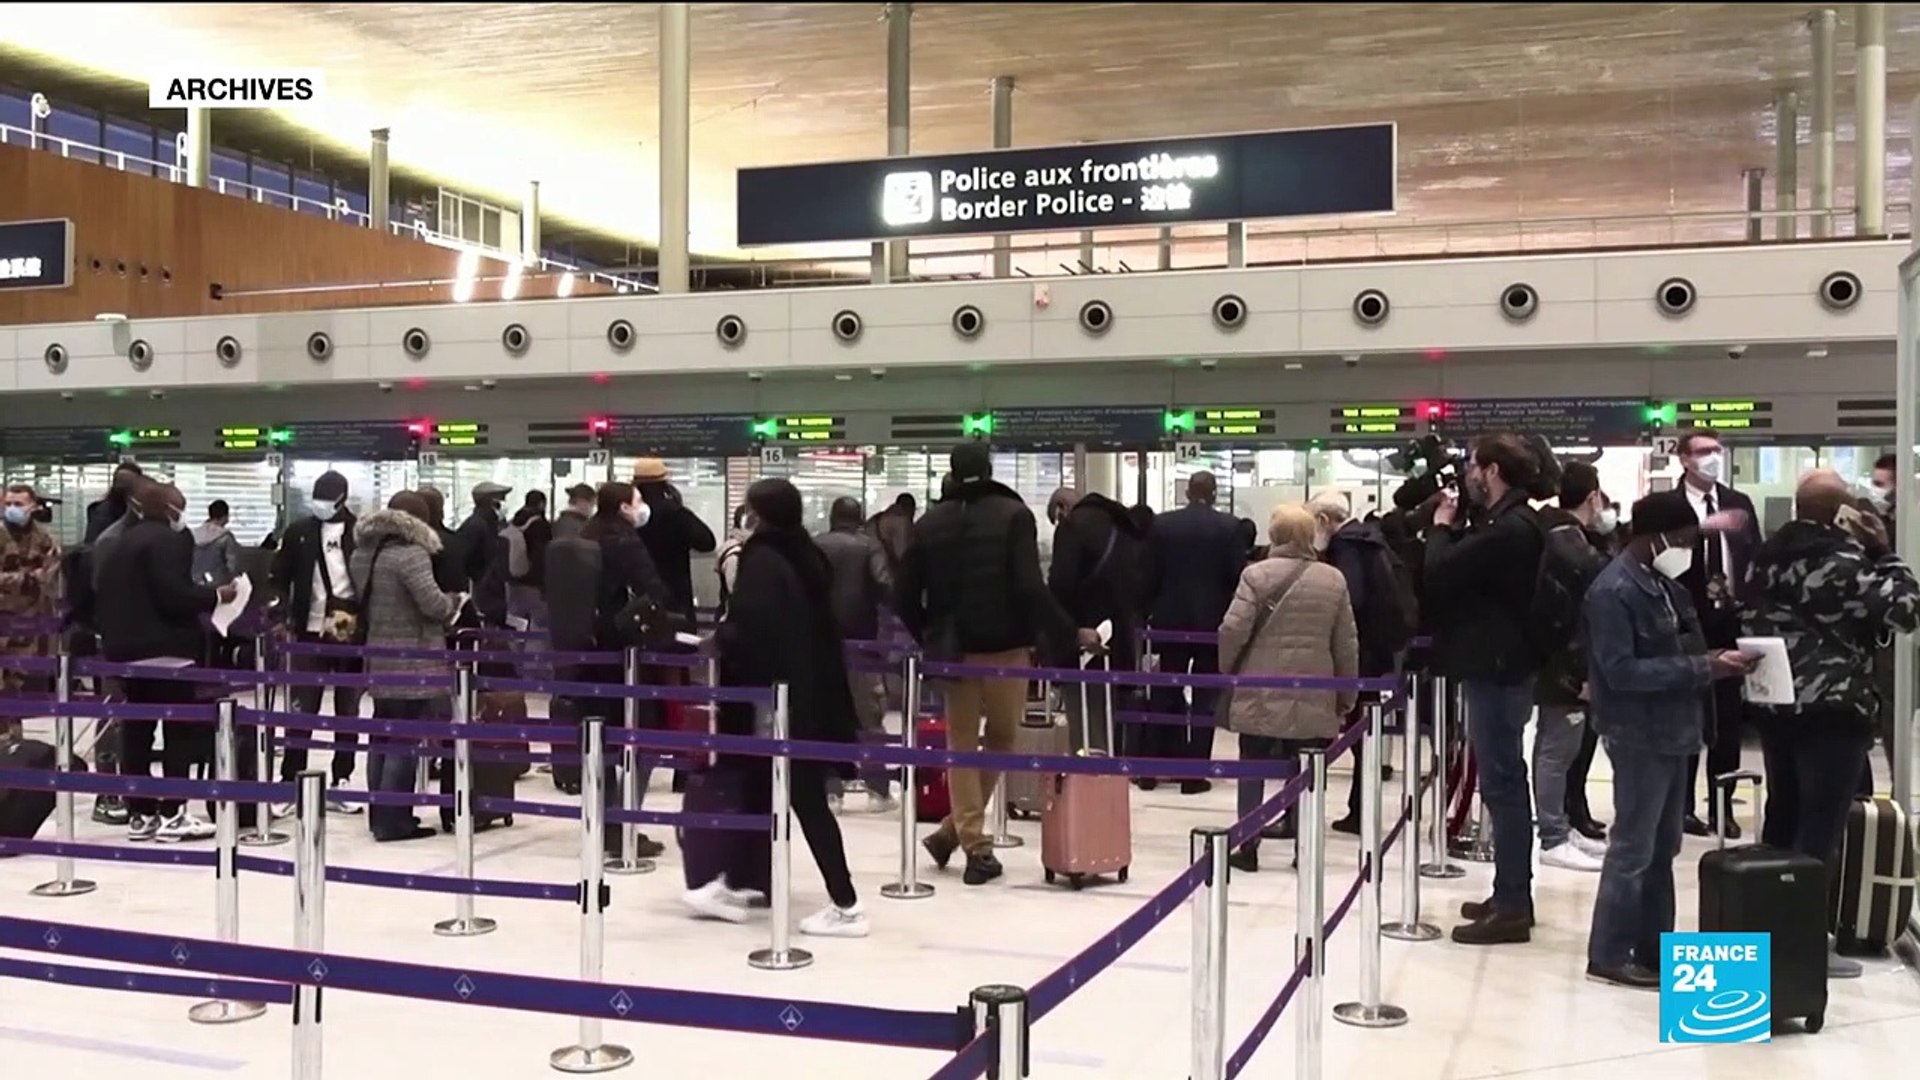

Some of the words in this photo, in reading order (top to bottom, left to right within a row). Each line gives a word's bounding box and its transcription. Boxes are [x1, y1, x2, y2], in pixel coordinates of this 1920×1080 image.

[940, 167, 1017, 193] Police
[1025, 166, 1073, 187] aux
[1080, 152, 1219, 182] frontières
[940, 196, 1029, 222] Border
[1036, 190, 1115, 216] Police
[1180, 446, 1197, 458] 14
[1657, 440, 1677, 454] 12
[593, 452, 607, 464] 17
[765, 450, 780, 462] 16
